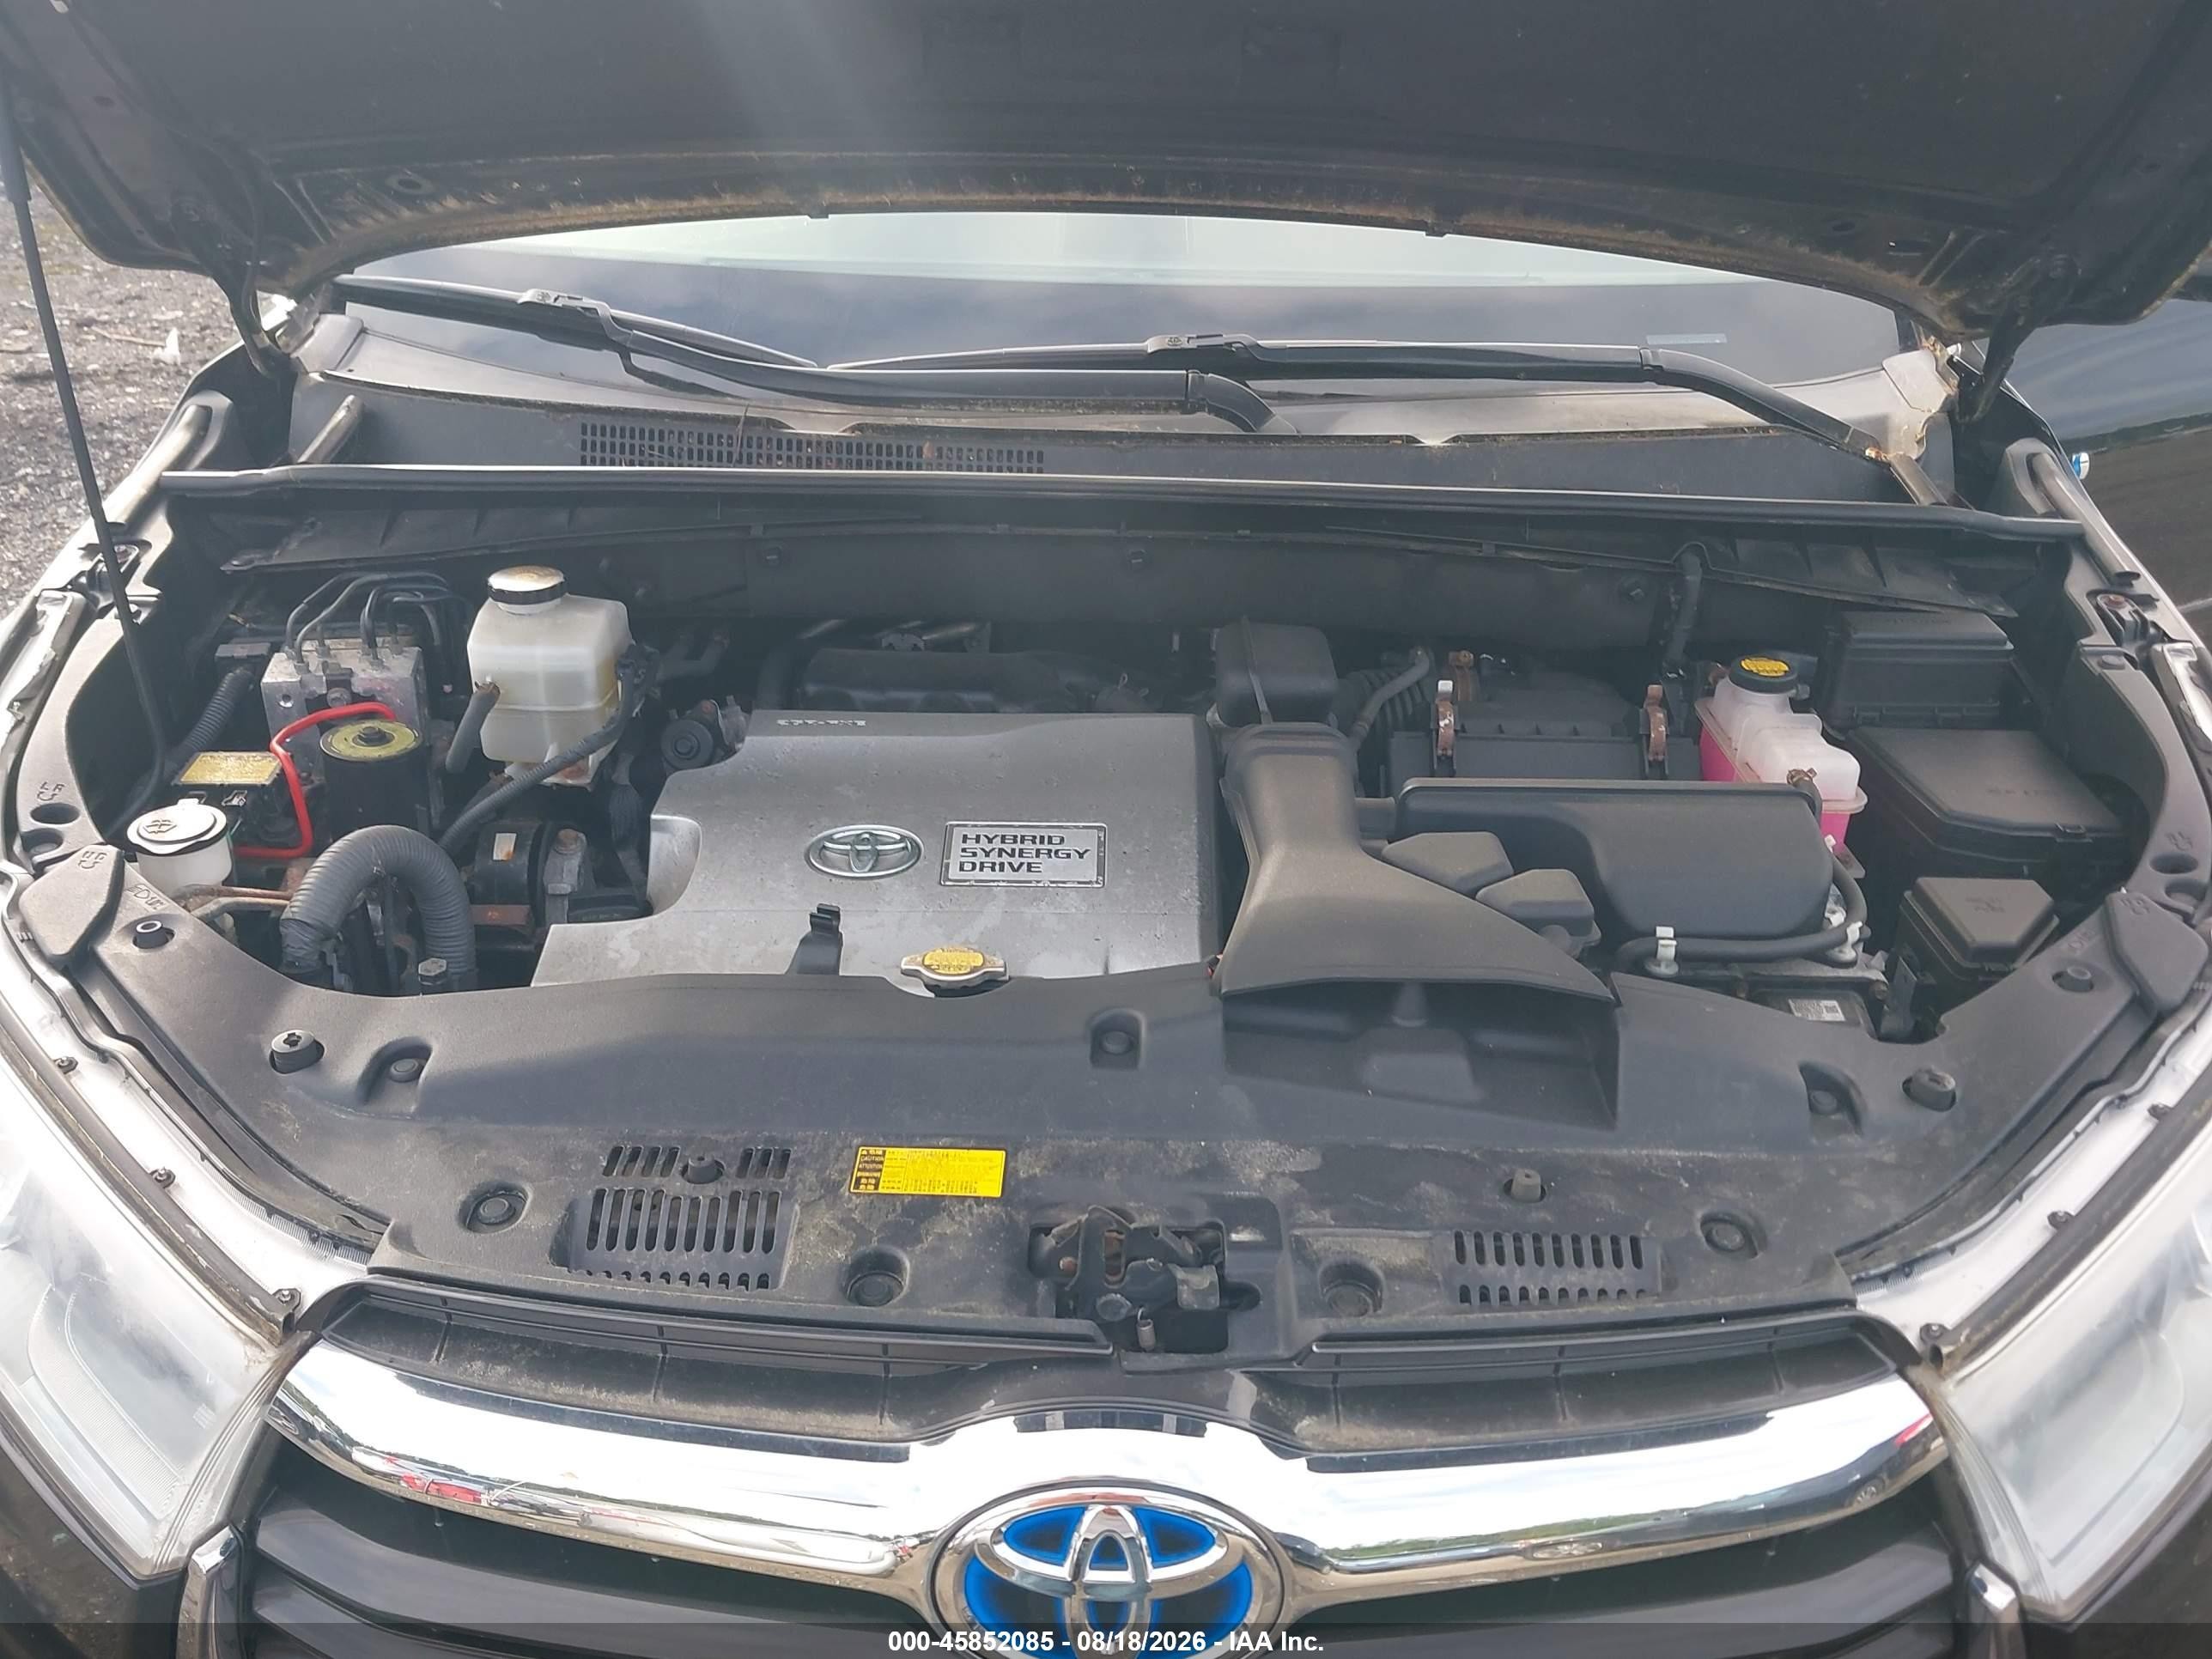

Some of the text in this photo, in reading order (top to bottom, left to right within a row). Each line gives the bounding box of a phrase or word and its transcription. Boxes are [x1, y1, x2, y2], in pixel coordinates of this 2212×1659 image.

[961, 833, 1065, 846] HYBRID
[960, 847, 1091, 860] SYNERGY
[958, 860, 1042, 873] DRIVE
